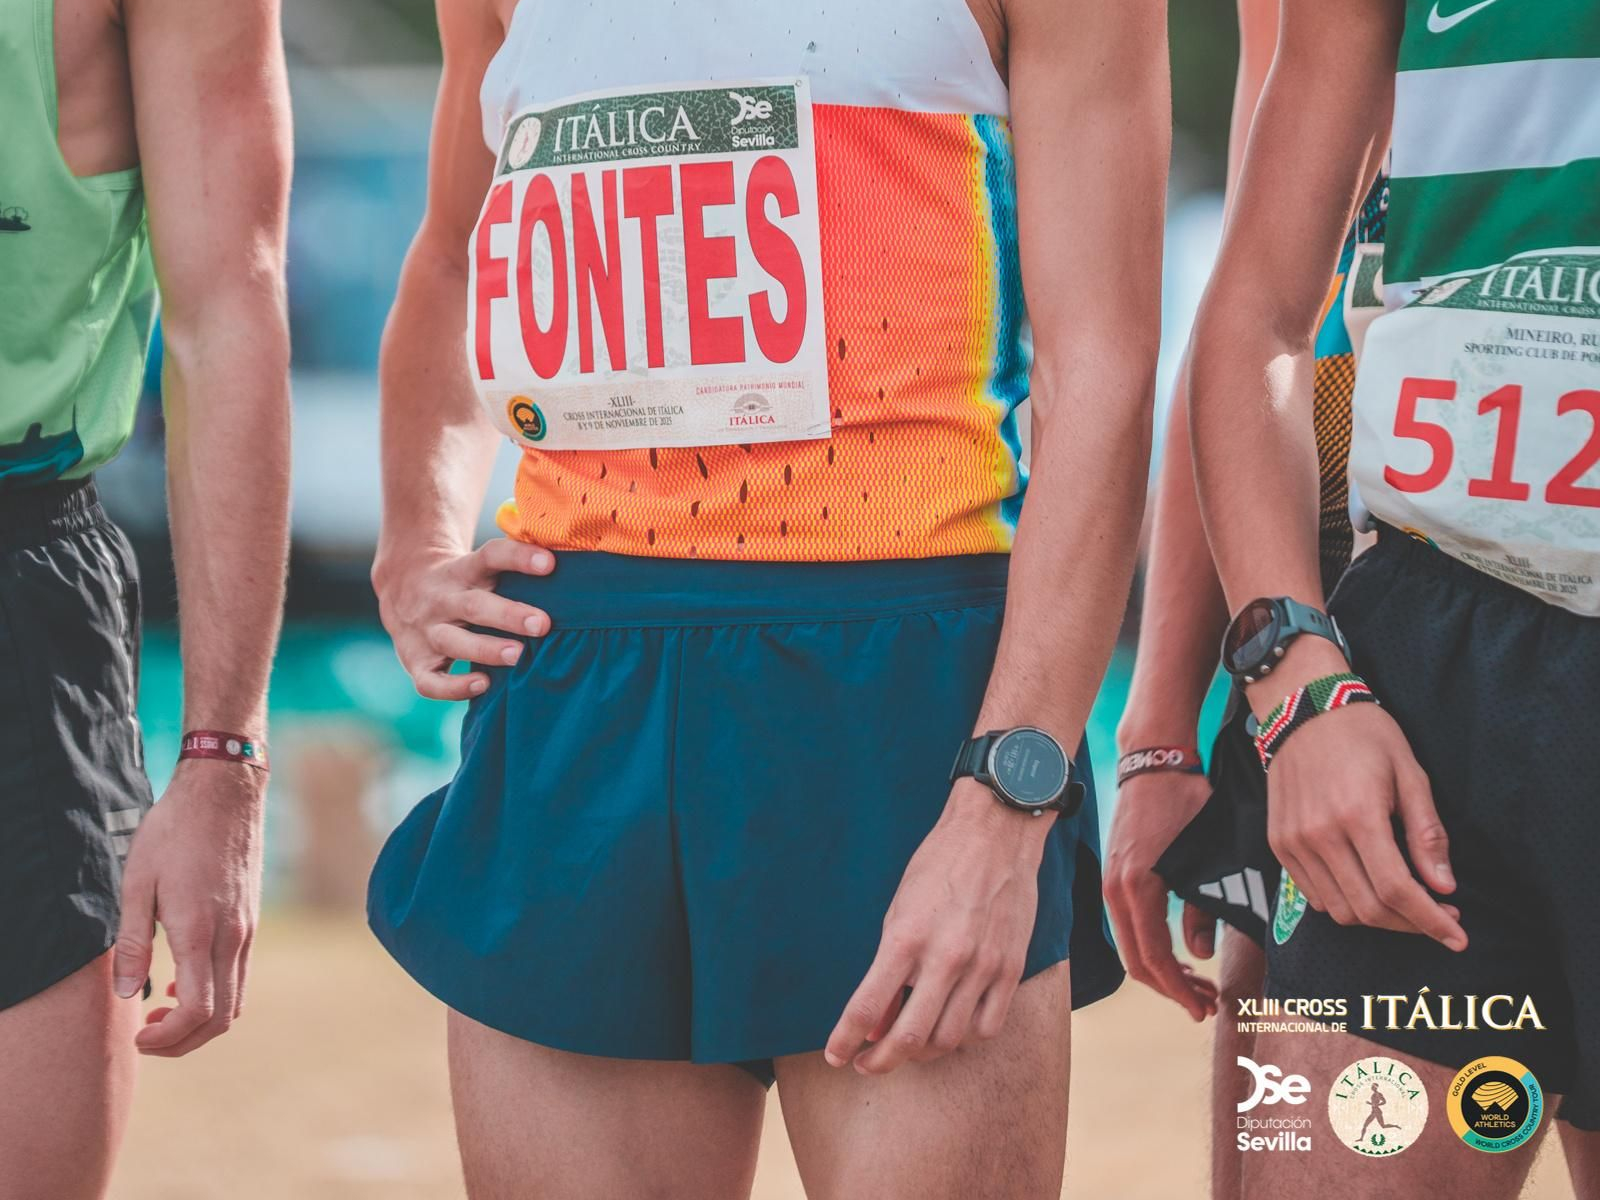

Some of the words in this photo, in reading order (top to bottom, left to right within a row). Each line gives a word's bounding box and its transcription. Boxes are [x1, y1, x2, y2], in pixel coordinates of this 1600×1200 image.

[553, 104, 702, 152] ITÁLICA
[732, 134, 775, 148] Sevilla
[553, 149, 620, 163] INTERNATIONAL
[621, 145, 649, 157] CROSS
[650, 142, 702, 154] COUNTRY
[475, 155, 808, 380] FONTES
[1506, 327, 1577, 346] MINEIRO,
[1463, 342, 1524, 357] SPORTING
[1525, 347, 1559, 360] CLUB
[1561, 350, 1578, 361] DE
[1580, 351, 1600, 363] PO
[695, 384, 737, 395] CANDIDATURA
[778, 380, 805, 390] MUNDIAL
[562, 411, 586, 421] CROSS
[586, 407, 646, 420] INTERNACIONAL
[647, 406, 657, 416] DE
[729, 413, 775, 426] ITÁLICA
[594, 421, 604, 430] DE
[605, 418, 647, 429] NOVIEMBRE
[649, 417, 659, 426] DE
[1383, 377, 1600, 509] 512
